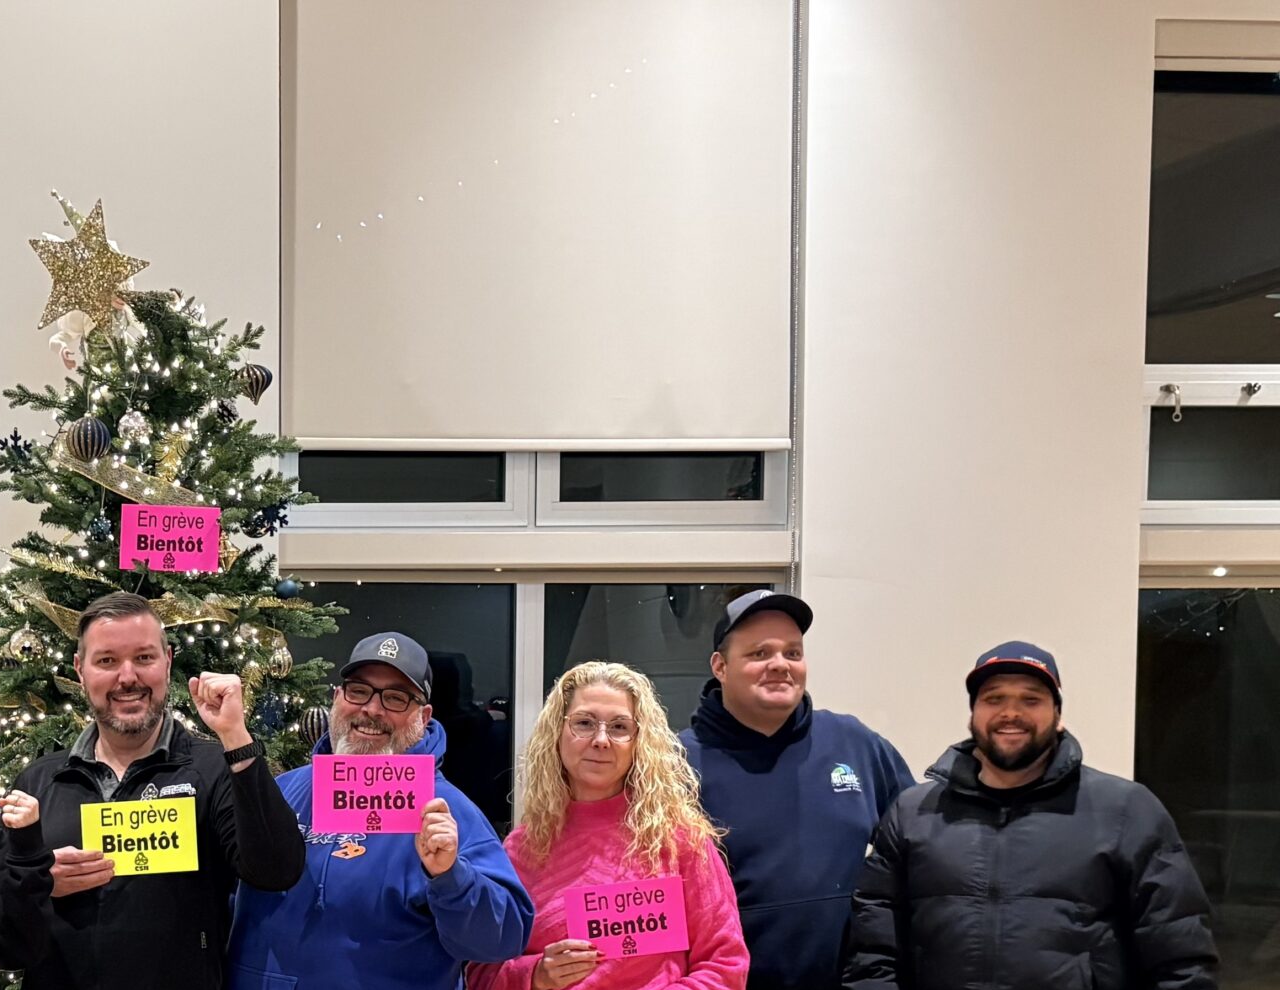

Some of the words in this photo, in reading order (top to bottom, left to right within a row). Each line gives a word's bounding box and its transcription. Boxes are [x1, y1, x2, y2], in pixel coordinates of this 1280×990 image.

[138, 510, 157, 528] En
[162, 512, 204, 532] grève
[137, 534, 203, 553] Bientôt
[333, 761, 357, 782] En
[363, 761, 415, 787] grève
[333, 789, 415, 810] Bientôt
[101, 807, 124, 827] En
[129, 804, 178, 830] grève
[102, 831, 179, 853] Bientôt
[584, 892, 609, 912] En
[614, 886, 665, 913] grève
[587, 912, 668, 939] Bientôt
